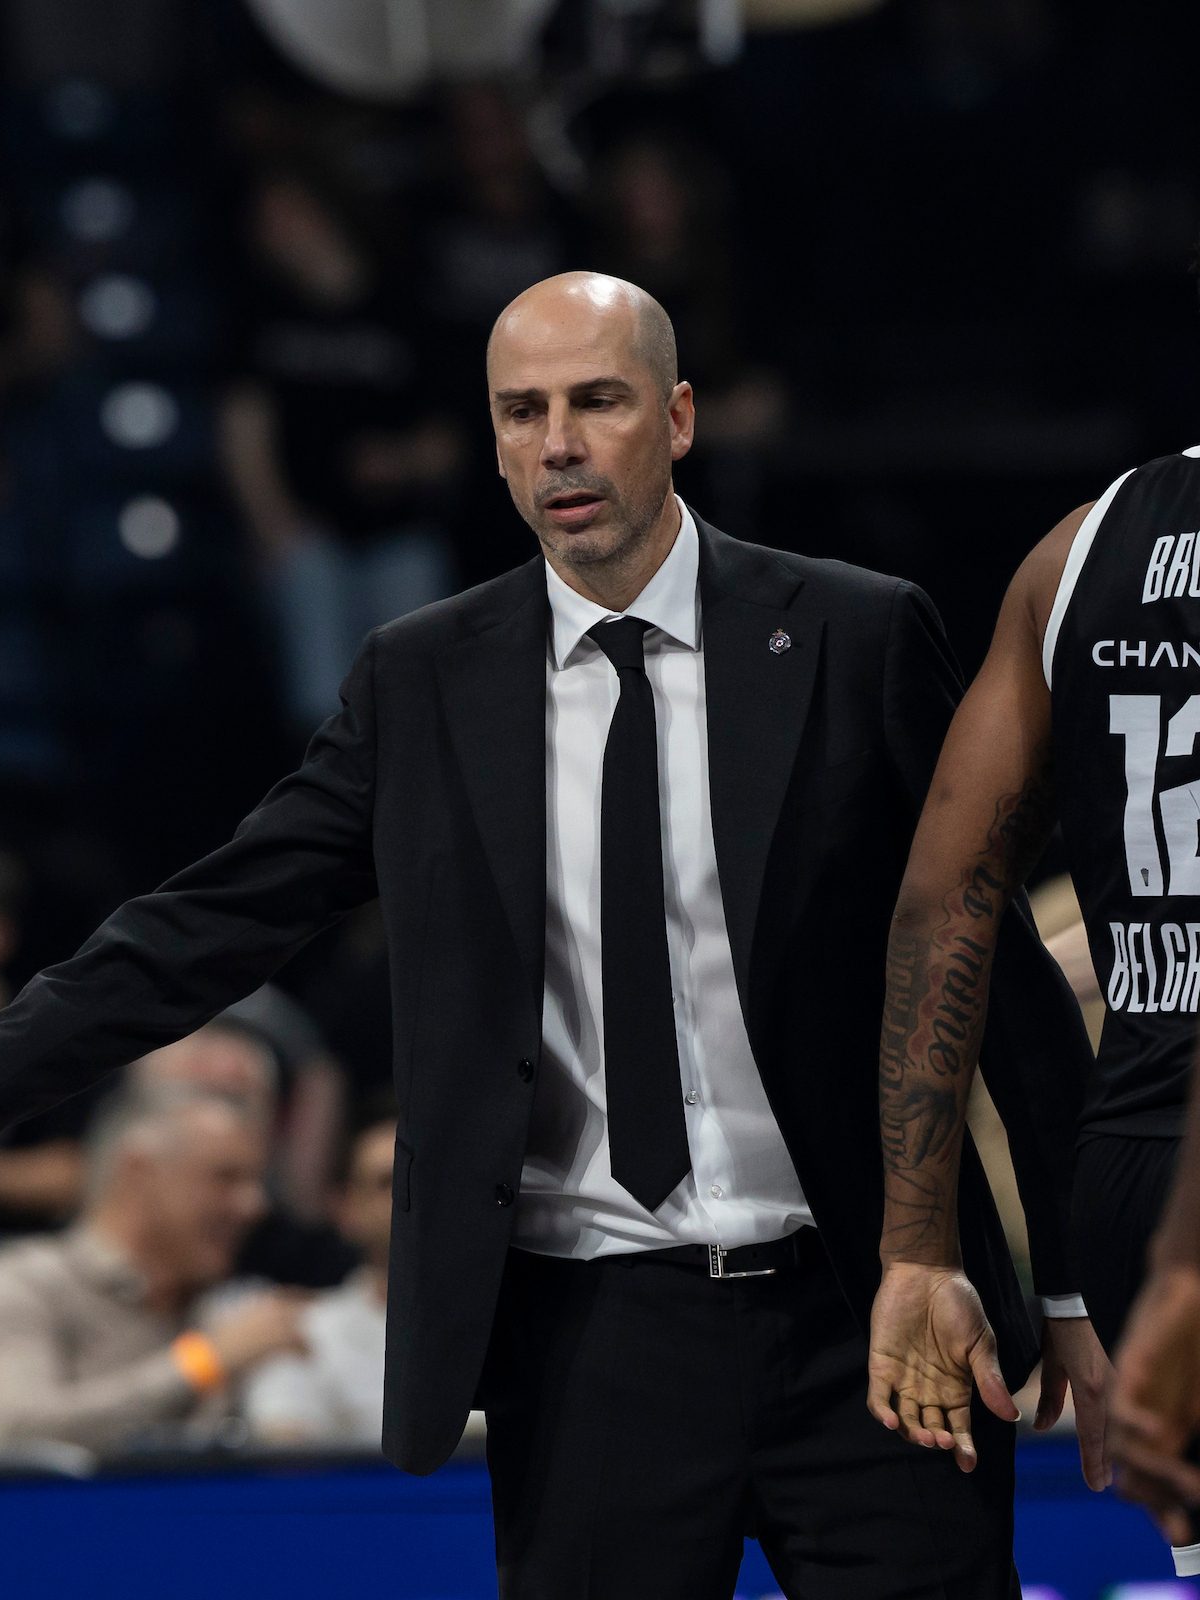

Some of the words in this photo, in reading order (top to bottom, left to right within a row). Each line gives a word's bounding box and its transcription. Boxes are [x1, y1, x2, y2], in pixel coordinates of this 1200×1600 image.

[1092, 640, 1200, 667] CHAN
[1109, 695, 1200, 897] 12
[928, 936, 989, 1076] mine
